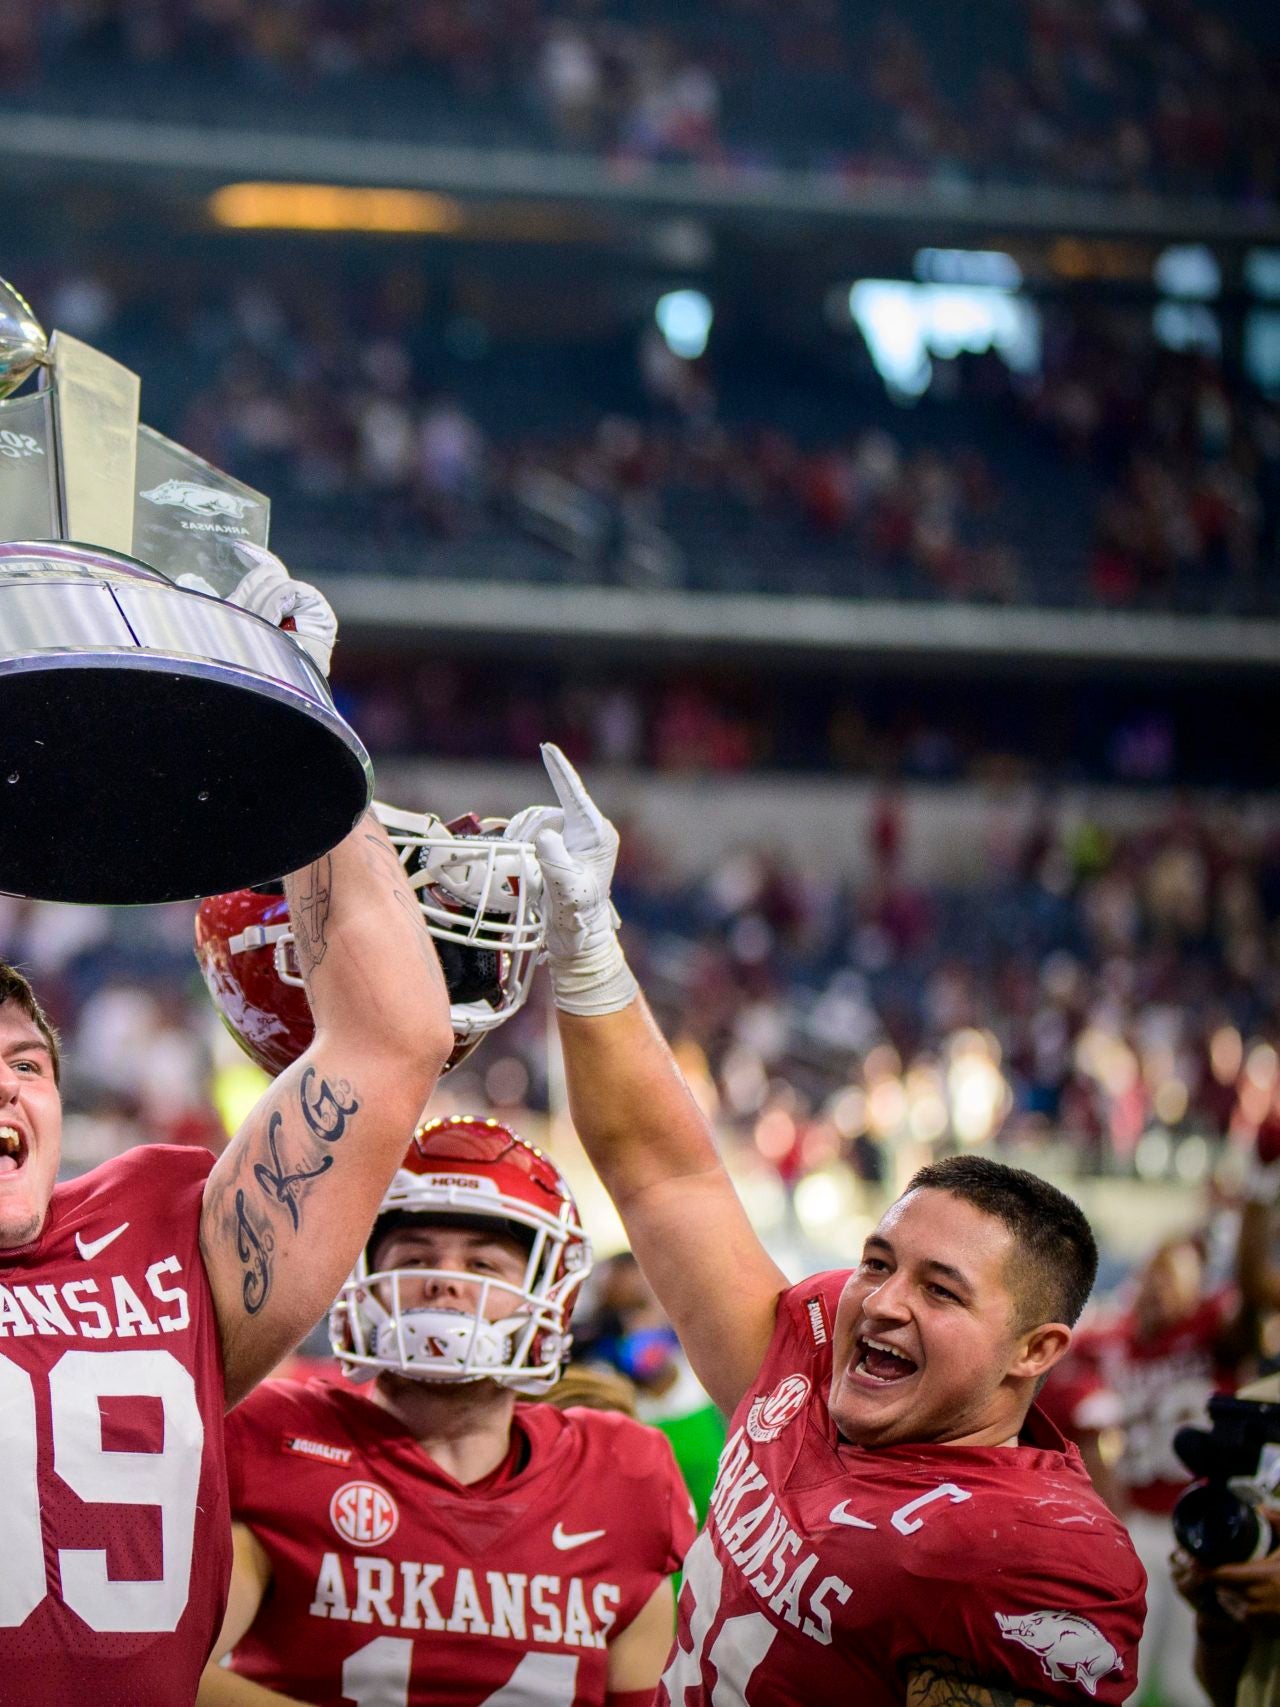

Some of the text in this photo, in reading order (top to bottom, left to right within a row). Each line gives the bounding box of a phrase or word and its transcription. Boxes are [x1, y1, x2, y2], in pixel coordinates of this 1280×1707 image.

[431, 1177, 480, 1189] HOGS
[806, 1302, 827, 1346] EQUALITY
[763, 1377, 807, 1425] SEC
[338, 1486, 392, 1541] SEC
[890, 1483, 972, 1536] C
[309, 1552, 621, 1650] ARKANSAS
